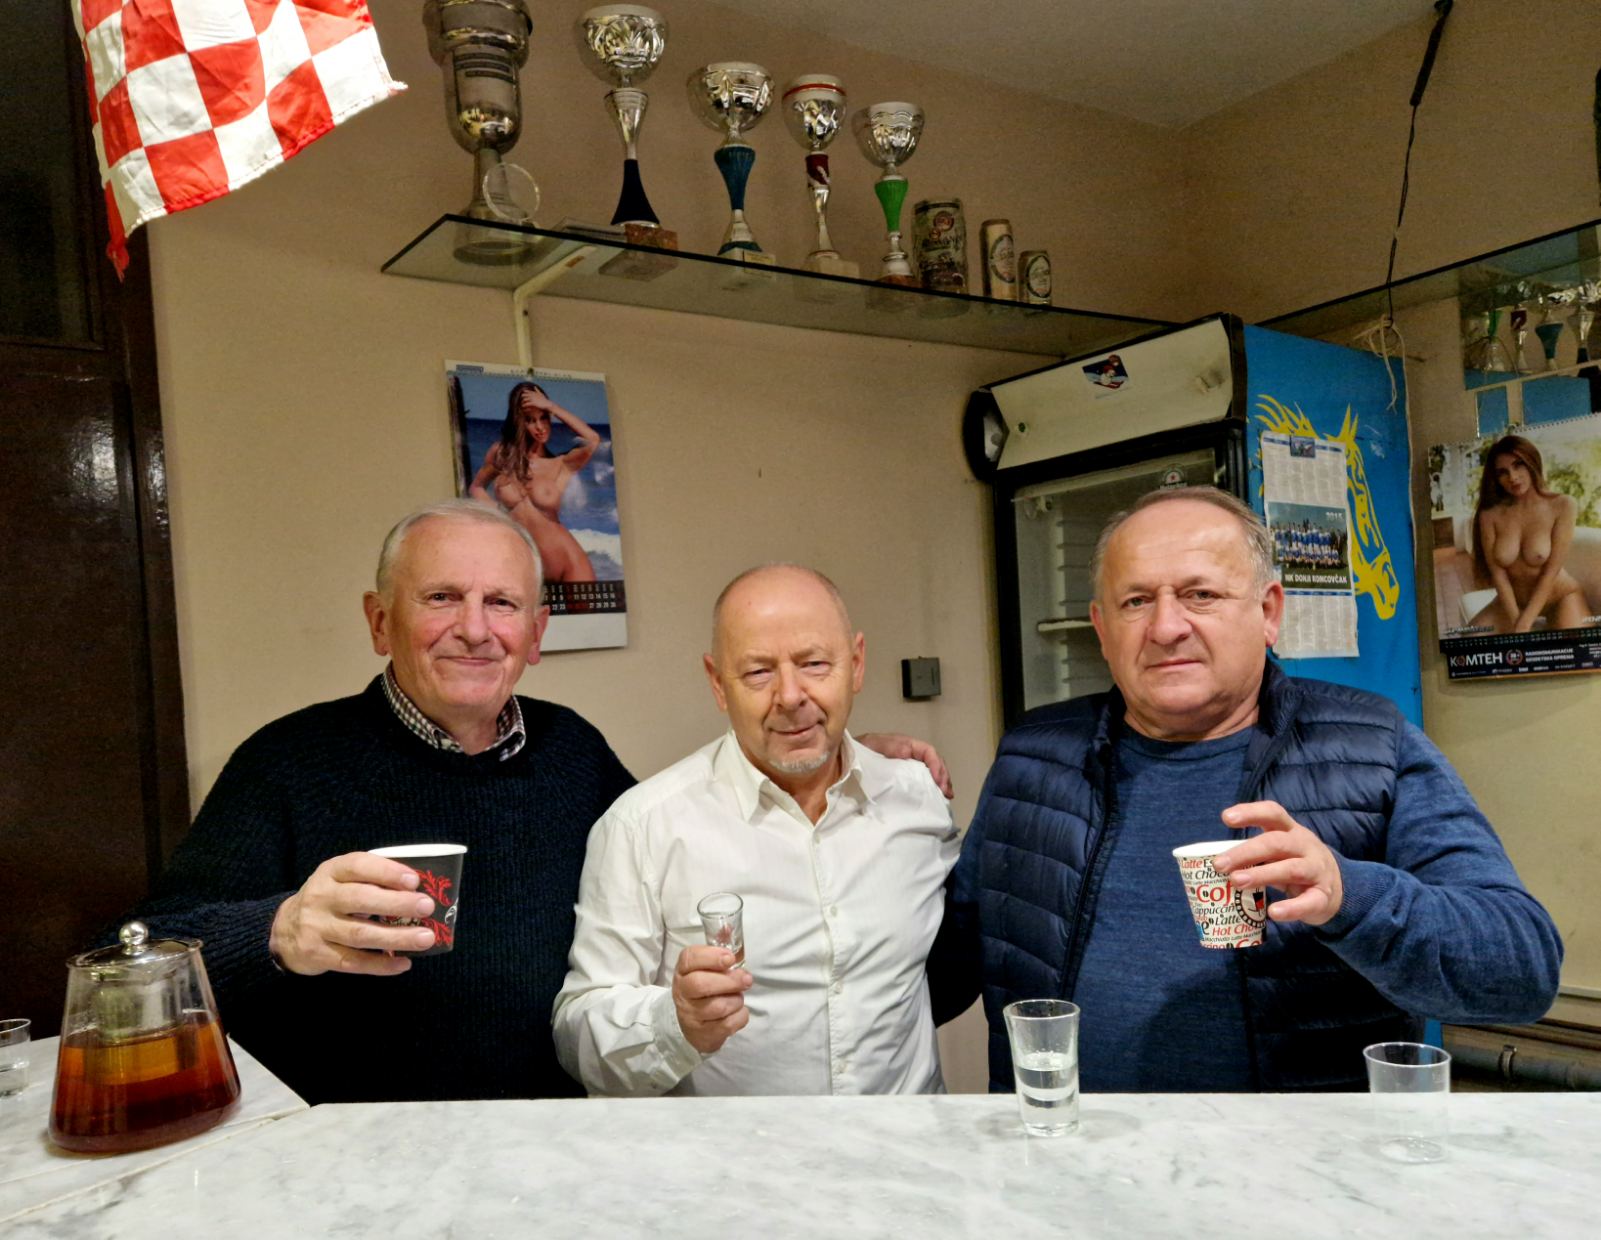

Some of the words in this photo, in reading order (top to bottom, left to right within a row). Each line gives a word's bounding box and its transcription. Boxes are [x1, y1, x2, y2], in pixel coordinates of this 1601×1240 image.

[1450, 652, 1503, 668] KOMTEH
[1215, 915, 1241, 927] Latte
[1212, 925, 1231, 937] Hot
